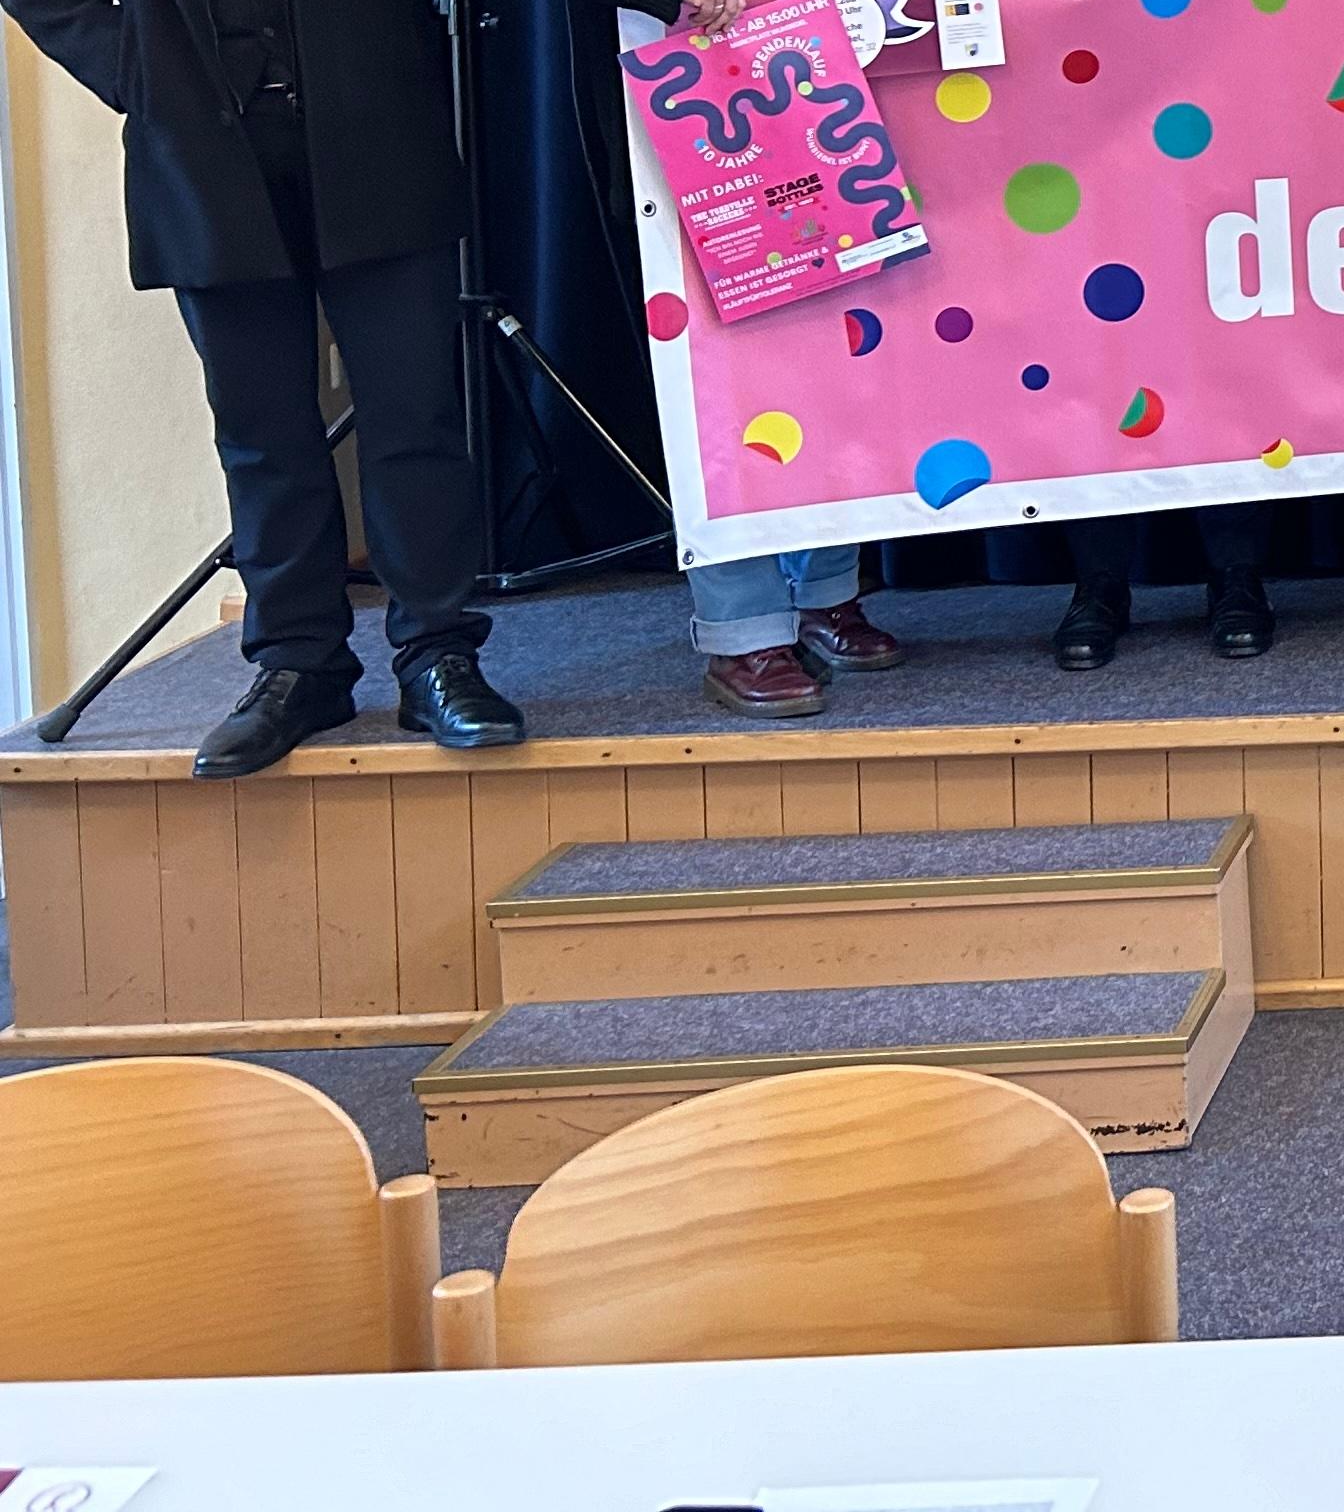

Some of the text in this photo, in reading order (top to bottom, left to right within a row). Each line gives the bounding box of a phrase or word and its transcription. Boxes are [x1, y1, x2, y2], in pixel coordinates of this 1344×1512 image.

[747, 17, 766, 33] AB
[766, 6, 800, 24] 15:00
[751, 36, 827, 79] SPENDENLAUF
[698, 143, 764, 168] 10 JAHRE
[681, 174, 765, 207] MIT DABEI:
[764, 173, 821, 198] STAGE
[767, 183, 824, 207] BOTTLES
[714, 276, 732, 289] FÜR
[734, 266, 769, 285] WARME
[771, 250, 819, 271] GETRÄNKE
[718, 284, 748, 300] ESSEN
[749, 278, 764, 290] IST
[765, 264, 809, 284] GESORGT
